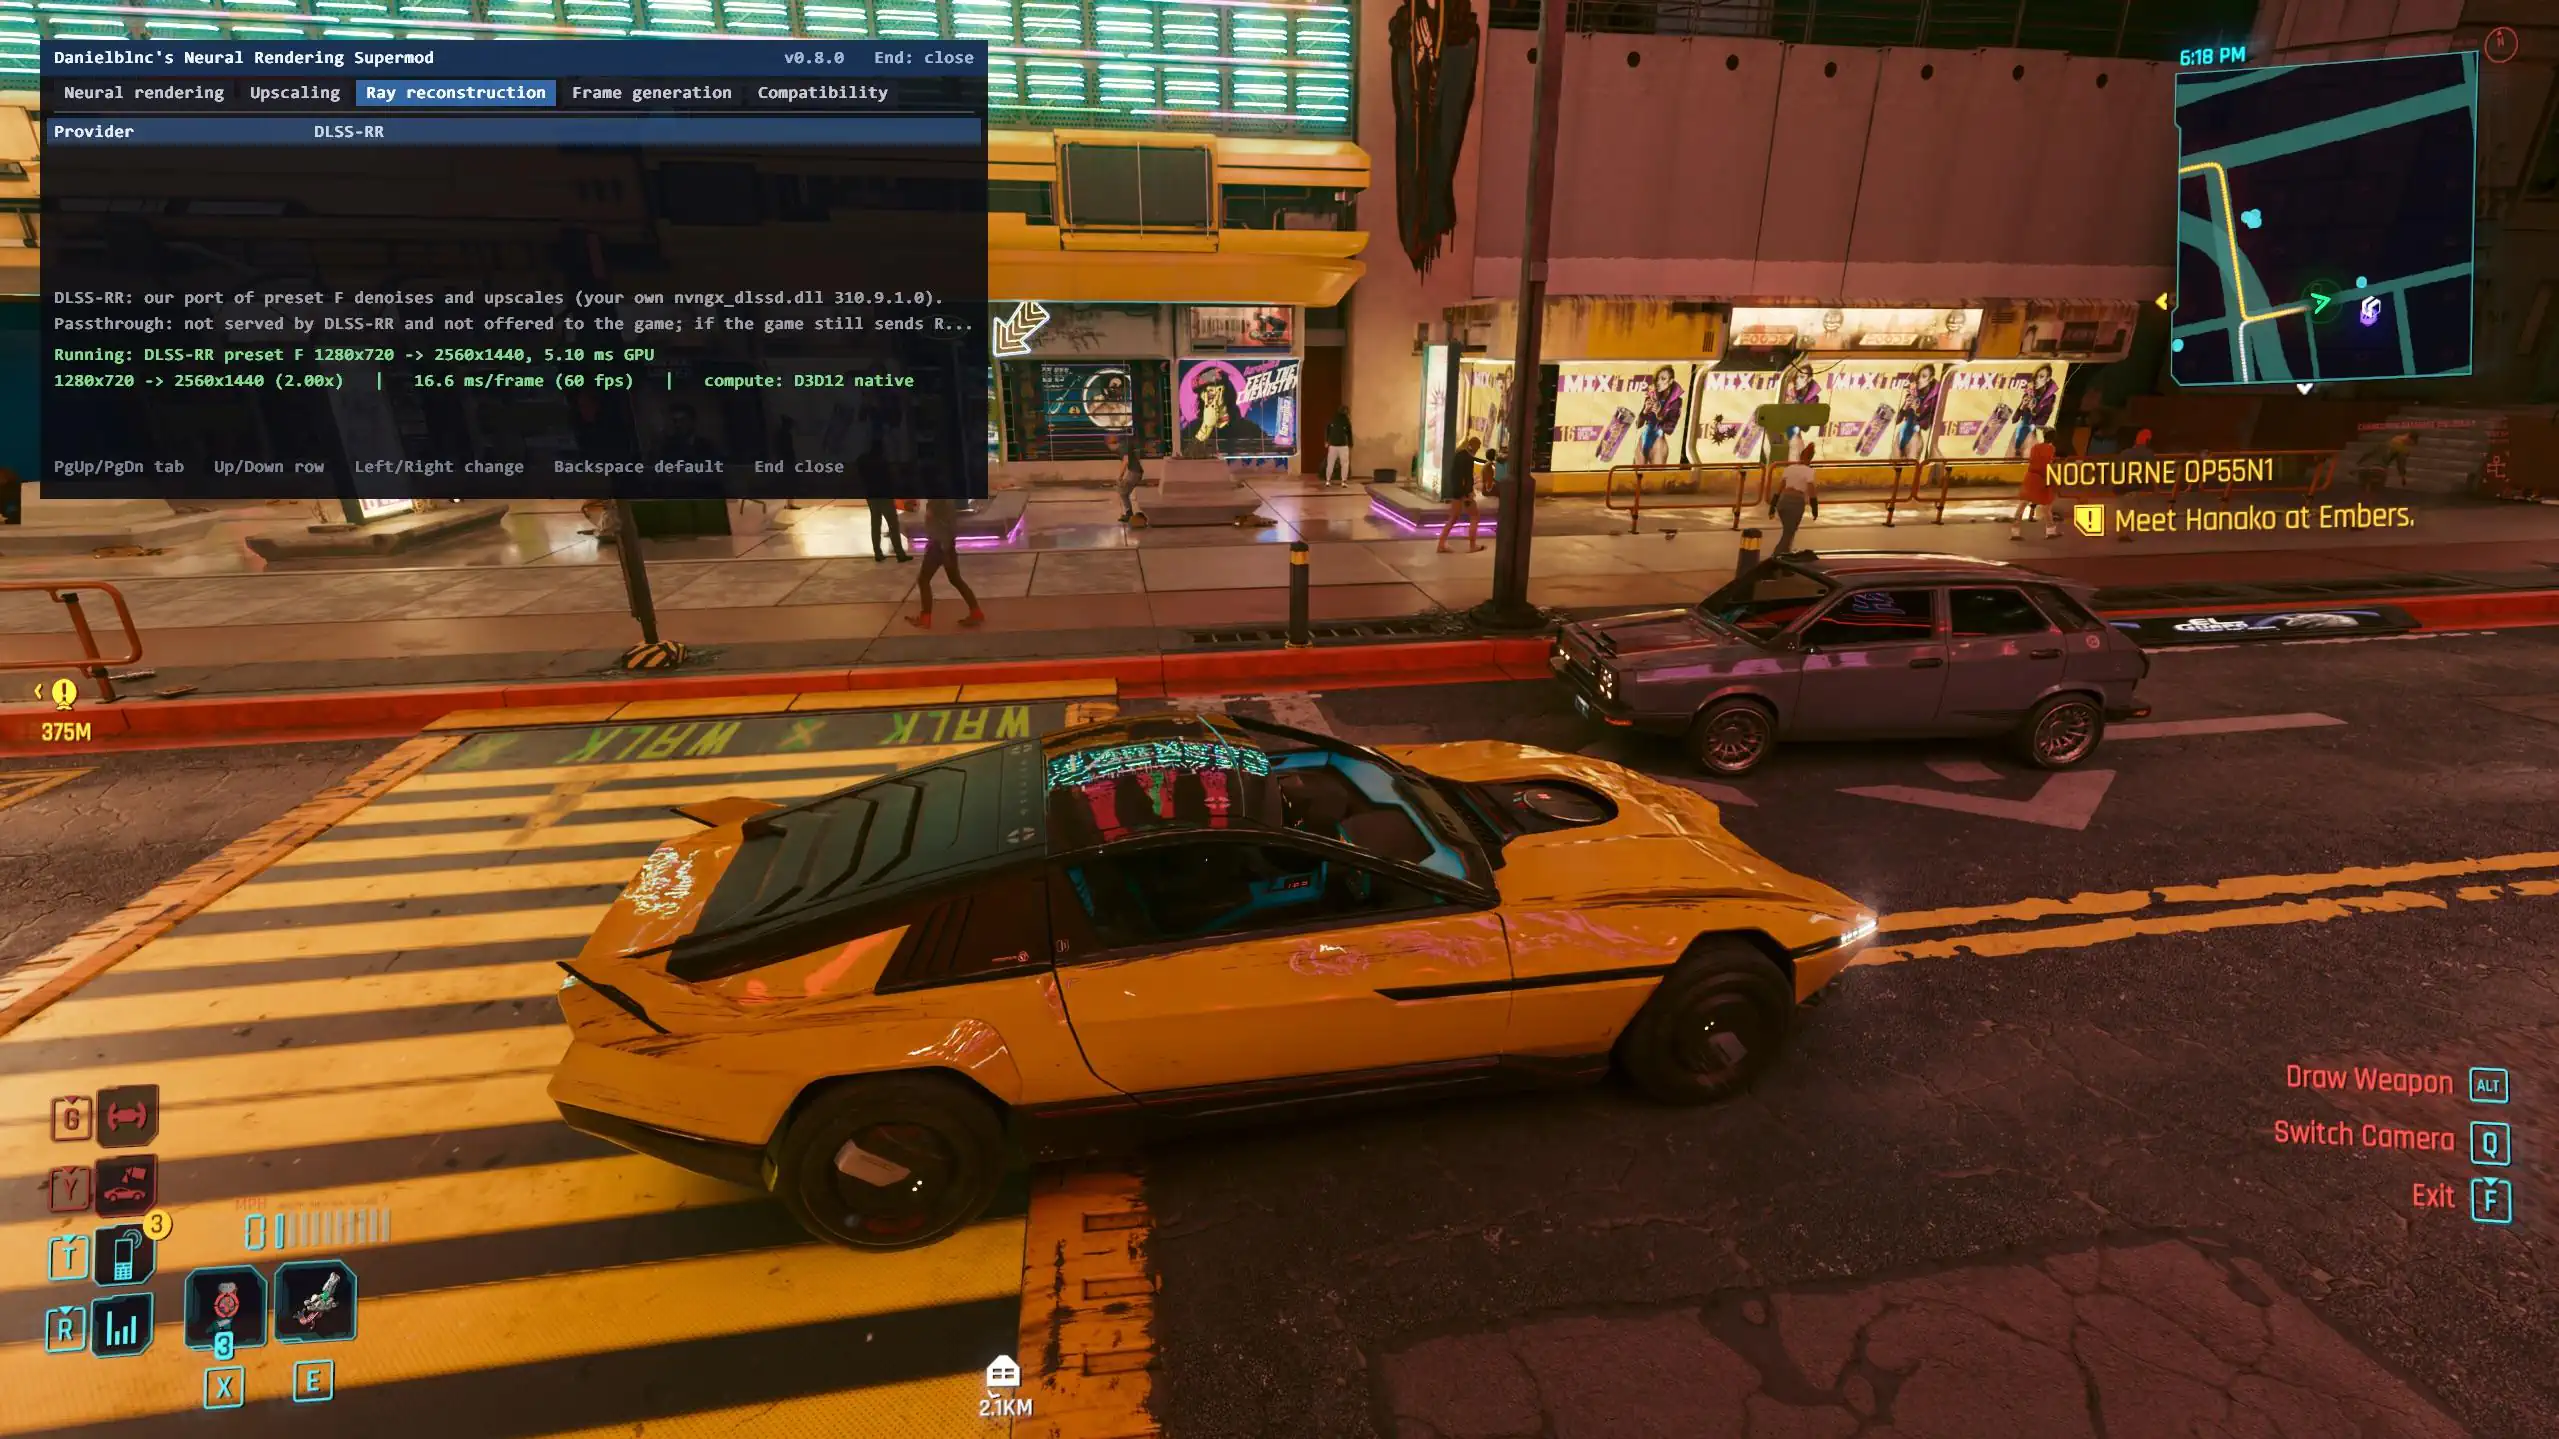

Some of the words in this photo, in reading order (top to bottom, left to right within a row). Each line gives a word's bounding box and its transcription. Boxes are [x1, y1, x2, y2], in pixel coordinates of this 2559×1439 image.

[1246, 370, 1273, 391] FEEL
[1276, 363, 1298, 381] THE
[1564, 374, 1612, 393] MIX
[1629, 380, 1649, 393] UP
[1705, 372, 1753, 391] MIX
[1833, 372, 1877, 390] MIX
[1892, 379, 1910, 390] UP
[1952, 372, 1997, 390] MIX
[2010, 378, 2028, 390] UP
